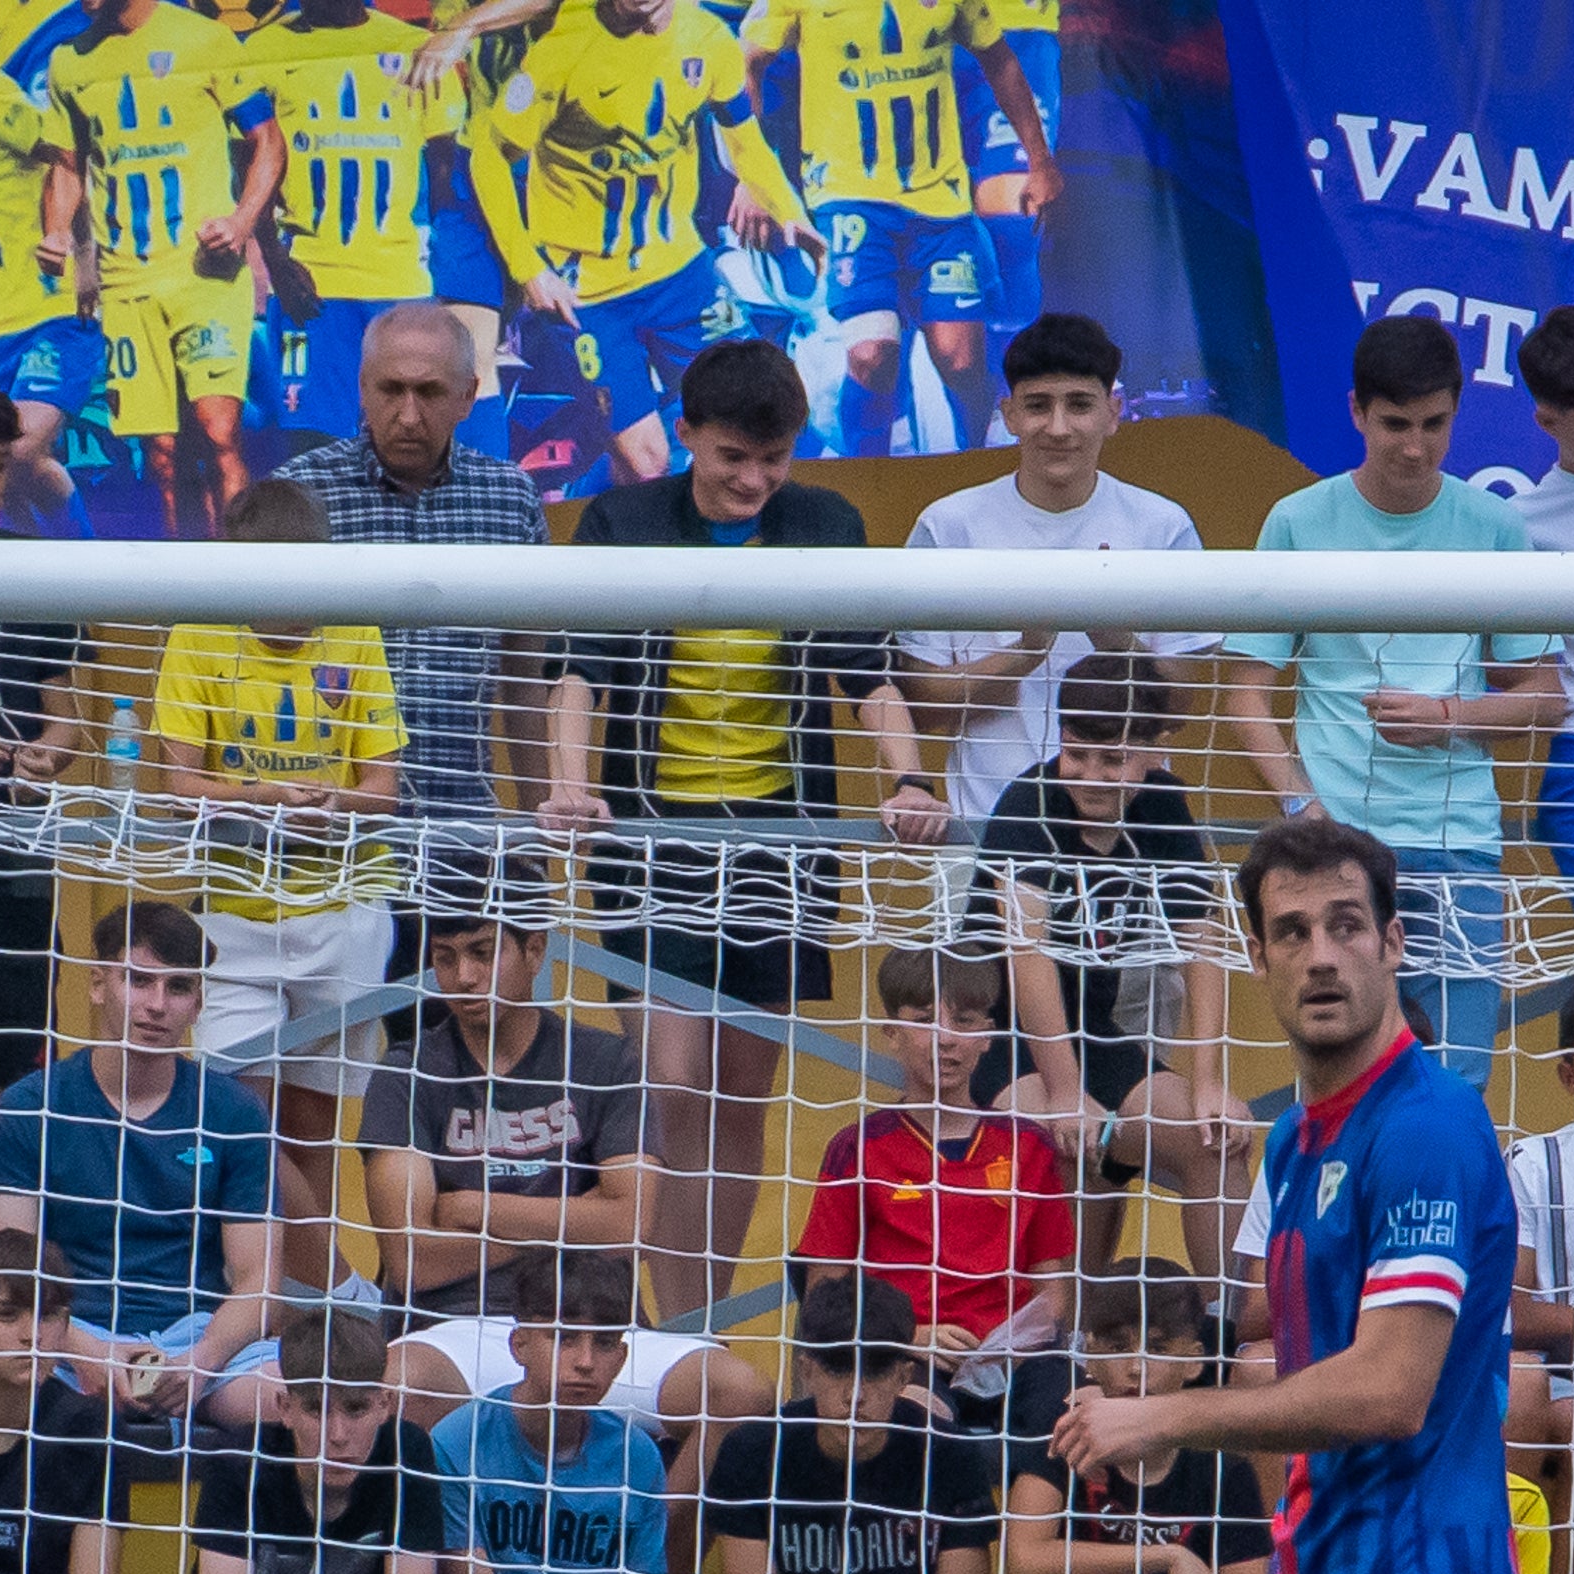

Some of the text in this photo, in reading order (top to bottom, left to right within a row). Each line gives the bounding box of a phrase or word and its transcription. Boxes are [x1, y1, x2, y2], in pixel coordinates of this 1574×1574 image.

[831, 213, 867, 254] 19
[574, 333, 602, 381] 8
[446, 1099, 583, 1156] GUESS
